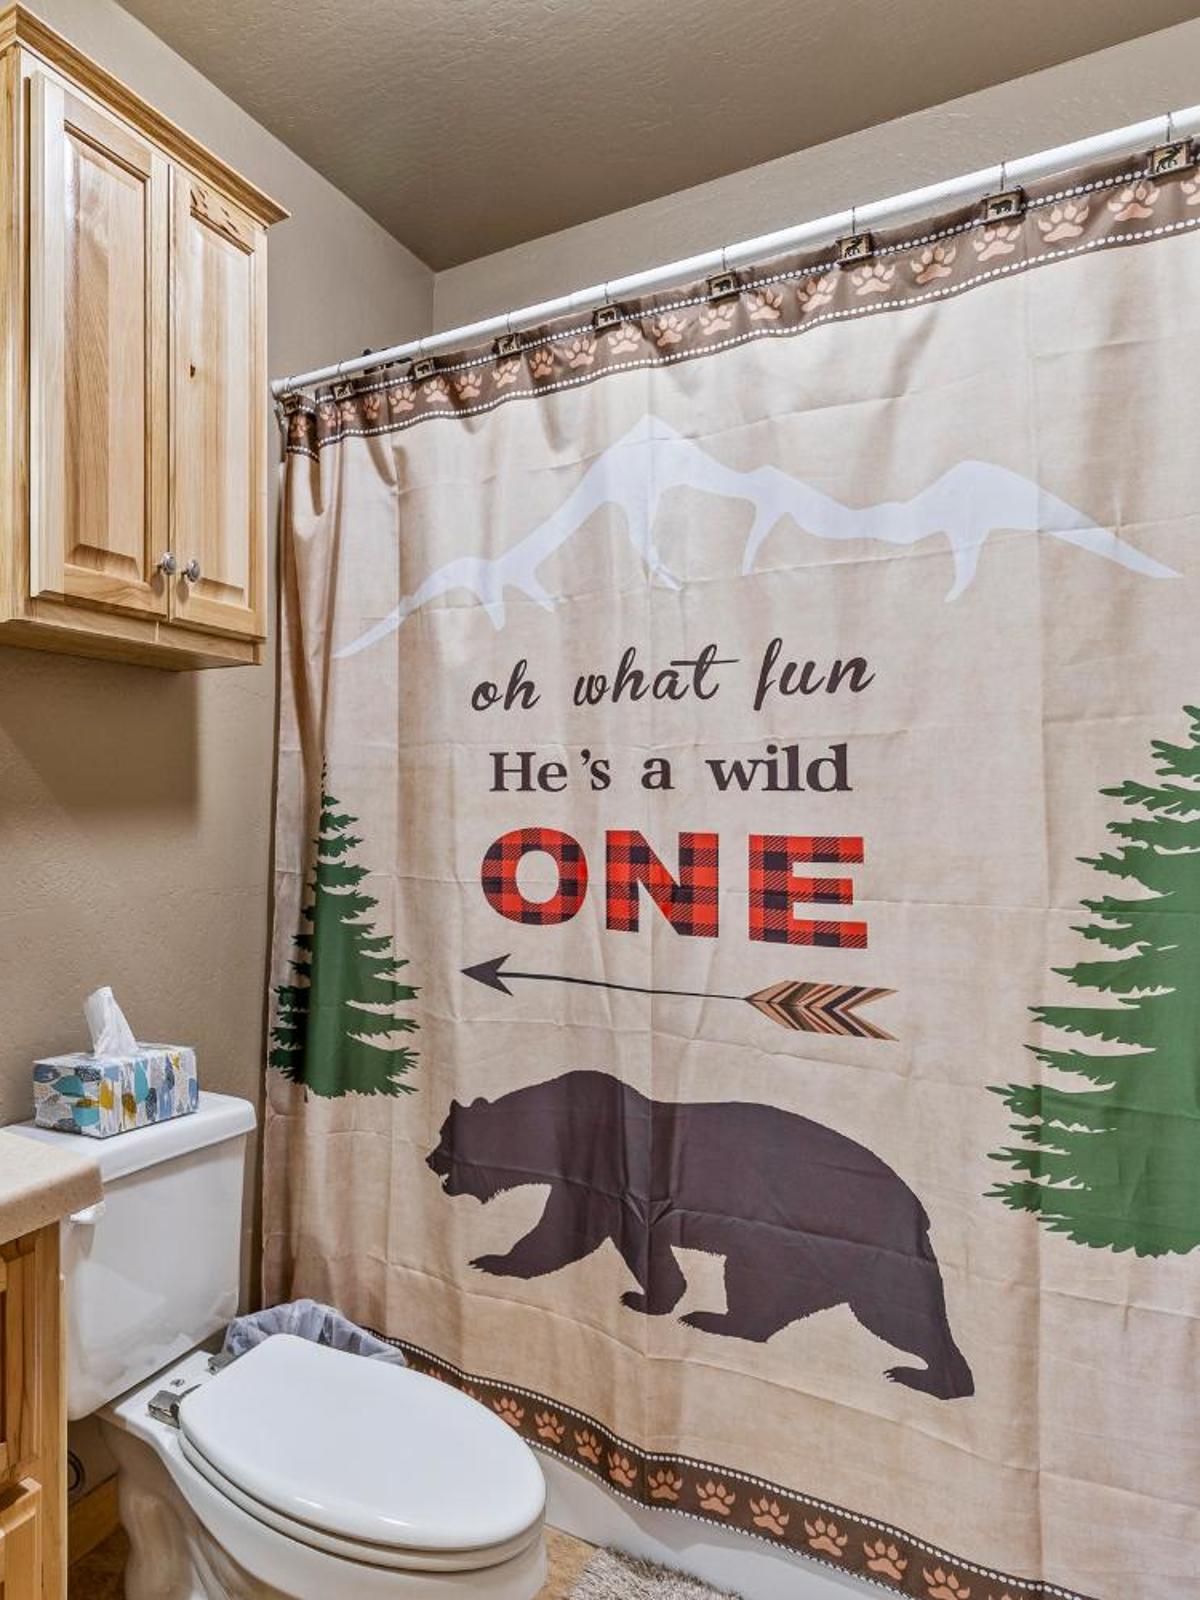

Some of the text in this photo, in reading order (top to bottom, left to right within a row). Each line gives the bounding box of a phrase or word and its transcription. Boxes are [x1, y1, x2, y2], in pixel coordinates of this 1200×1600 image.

[470, 637, 876, 711] oh what fun
[489, 742, 853, 793] He's a wild
[480, 826, 868, 950] ONE
